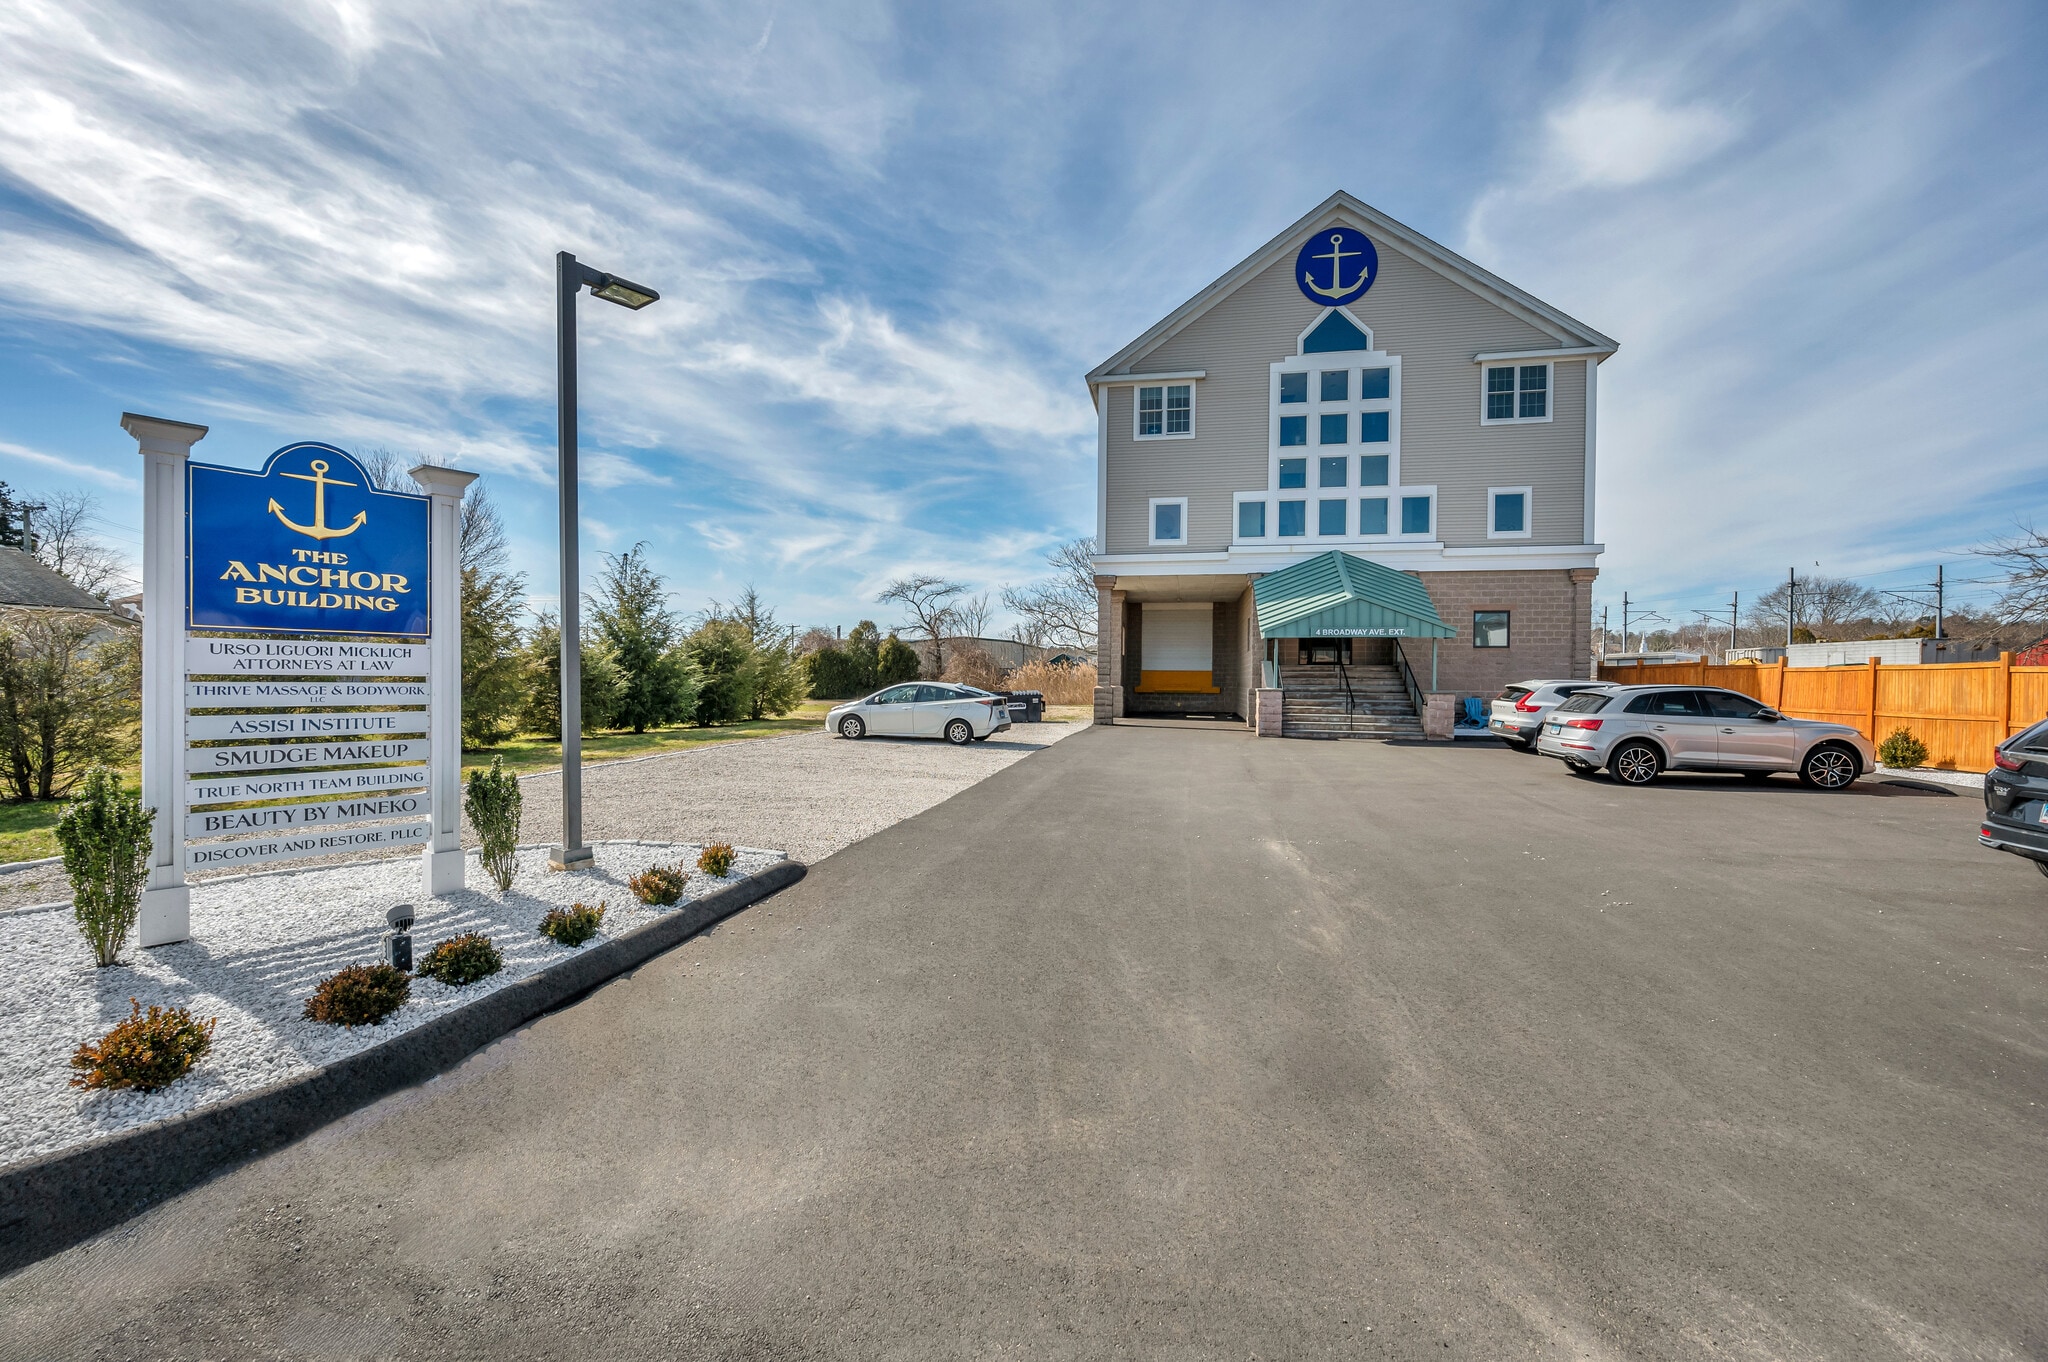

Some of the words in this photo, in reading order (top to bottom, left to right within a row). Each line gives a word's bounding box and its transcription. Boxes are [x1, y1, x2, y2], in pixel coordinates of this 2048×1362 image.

[292, 549, 348, 565] THE
[220, 560, 411, 594] ANCHOR
[236, 588, 399, 612] BUILDING
[210, 643, 260, 655] URSO
[266, 644, 333, 657] LIGUORI
[339, 646, 412, 658] MICKLICH
[233, 659, 333, 670] ATTORNEYS
[337, 660, 356, 670] AT
[361, 661, 394, 671] LAW
[193, 685, 251, 696] THRIVE
[256, 685, 327, 696] MASSAGE
[331, 686, 343, 695] &
[346, 685, 425, 695] BODYWORK
[230, 719, 295, 733] ASSISI
[302, 717, 396, 731] INSTITUTE
[215, 748, 317, 766] SMUDGE
[324, 744, 408, 761] MAKEUP
[195, 785, 241, 798] TRUE
[245, 781, 304, 795] NORTH
[309, 777, 352, 790] TEAM
[357, 772, 424, 786] BUILDING
[205, 809, 296, 831] BEAUTY
[304, 807, 331, 821] BY
[337, 798, 417, 818] MINEKO
[194, 844, 278, 864] DISCOVER
[282, 839, 315, 853] AND
[320, 832, 386, 847] RESTORE,
[391, 827, 423, 840] PLLC
